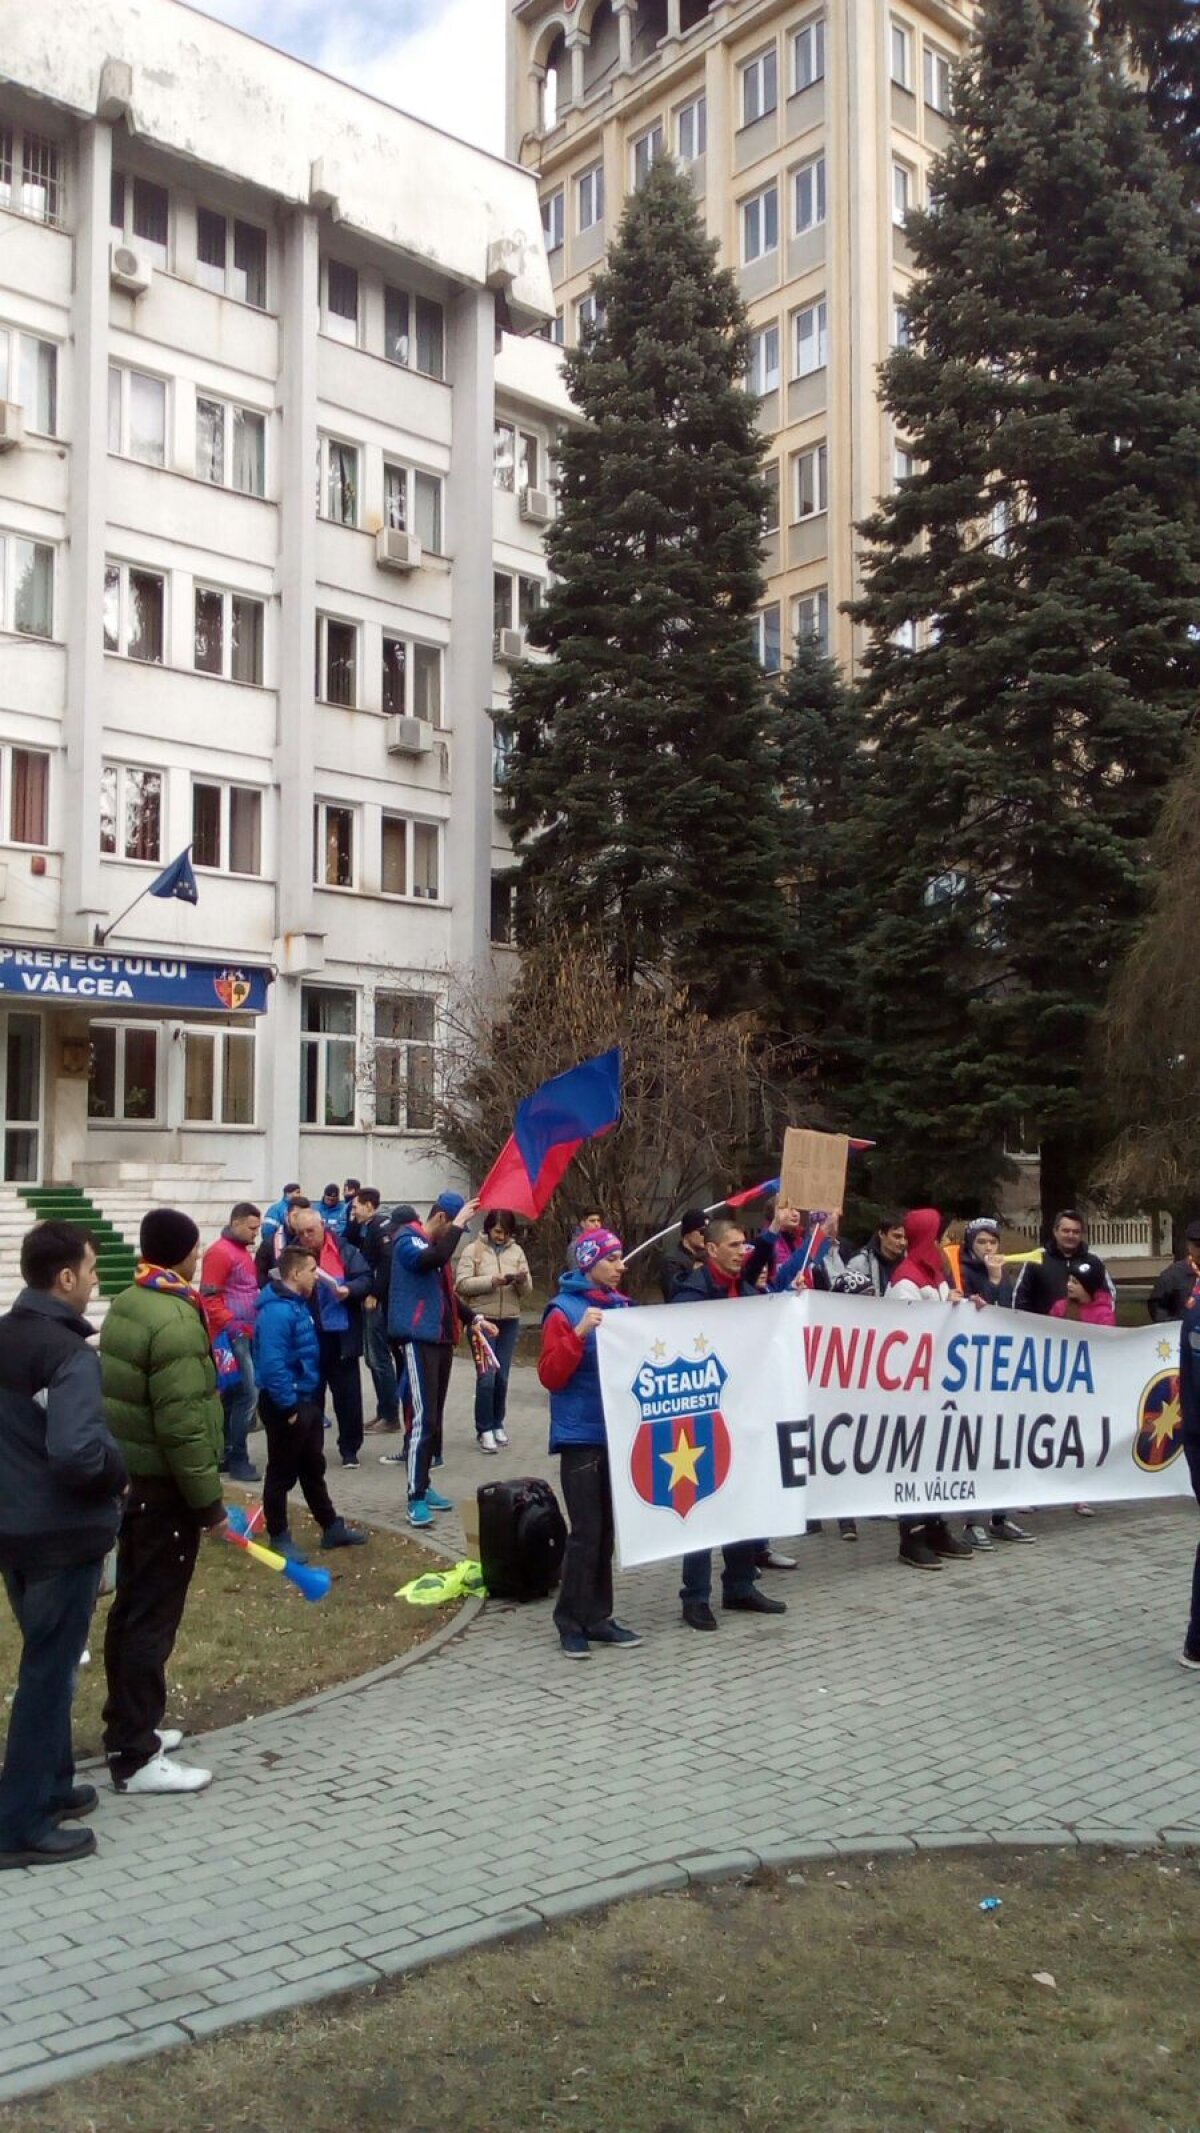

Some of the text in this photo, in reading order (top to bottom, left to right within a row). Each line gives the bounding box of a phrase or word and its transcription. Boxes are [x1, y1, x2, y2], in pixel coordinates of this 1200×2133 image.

[0, 948, 187, 979] PREFECTULUI
[21, 970, 134, 998] VÂLCEA
[639, 1359, 721, 1397] STEAUA
[941, 1333, 1095, 1394] STEAUA
[642, 1392, 719, 1417] BUCURESTI
[936, 1400, 983, 1473] ÎN
[993, 1412, 1085, 1470] LIGA
[895, 1476, 976, 1503] RM. VÂLCEA
